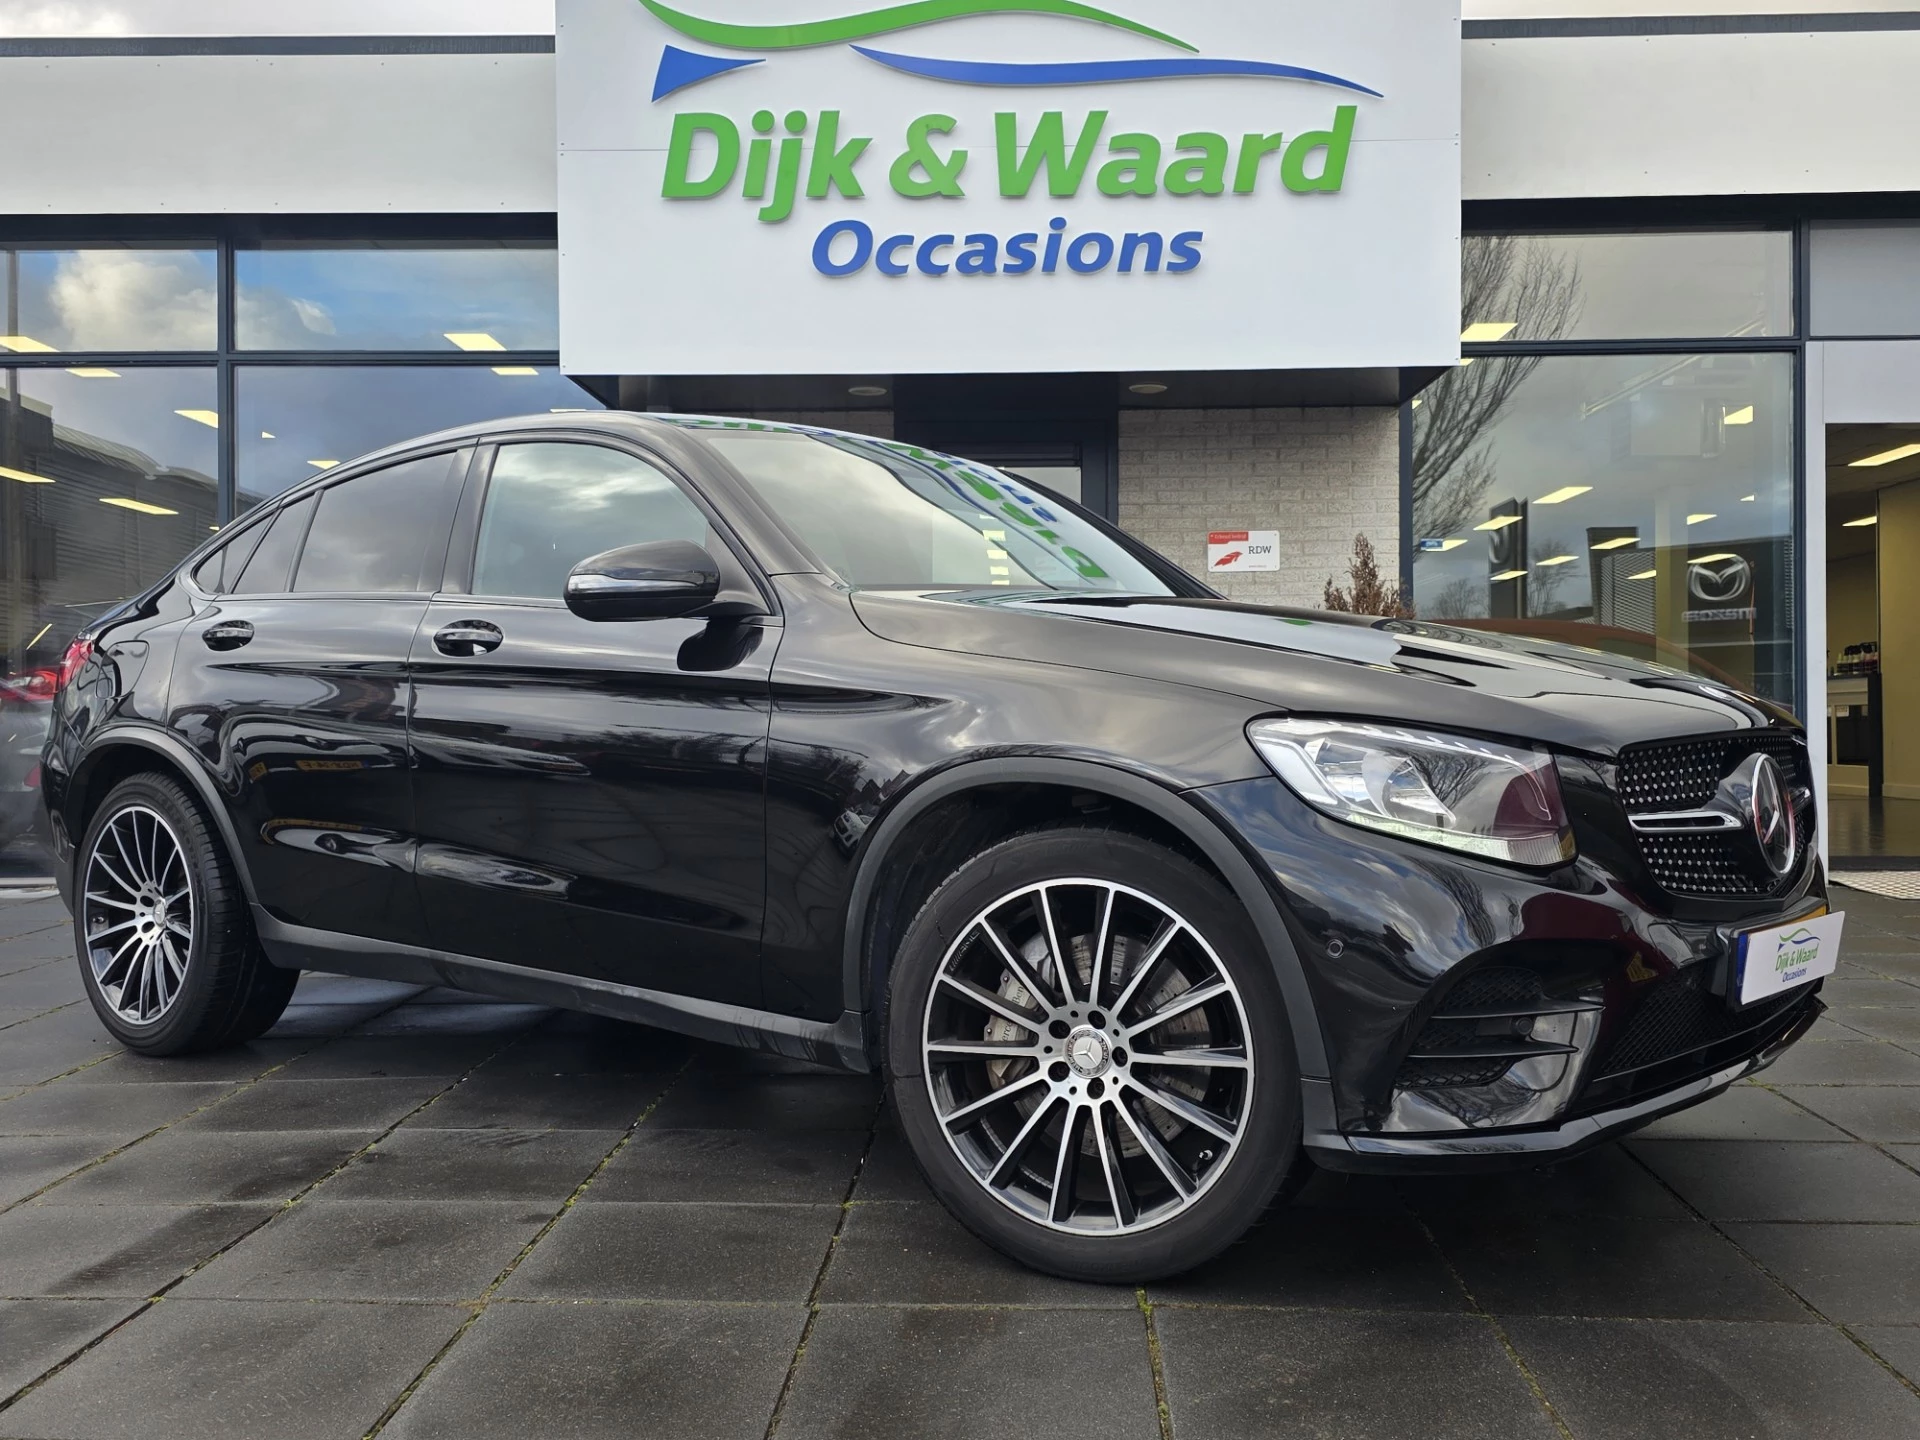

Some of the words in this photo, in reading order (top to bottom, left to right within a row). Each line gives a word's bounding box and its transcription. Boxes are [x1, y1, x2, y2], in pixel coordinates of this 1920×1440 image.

[661, 110, 874, 223] Dijk
[888, 113, 969, 198] &
[994, 104, 1359, 199] Waard
[811, 216, 1204, 279] Occasions
[1248, 545, 1272, 555] RDW
[1796, 943, 1819, 964] Waard
